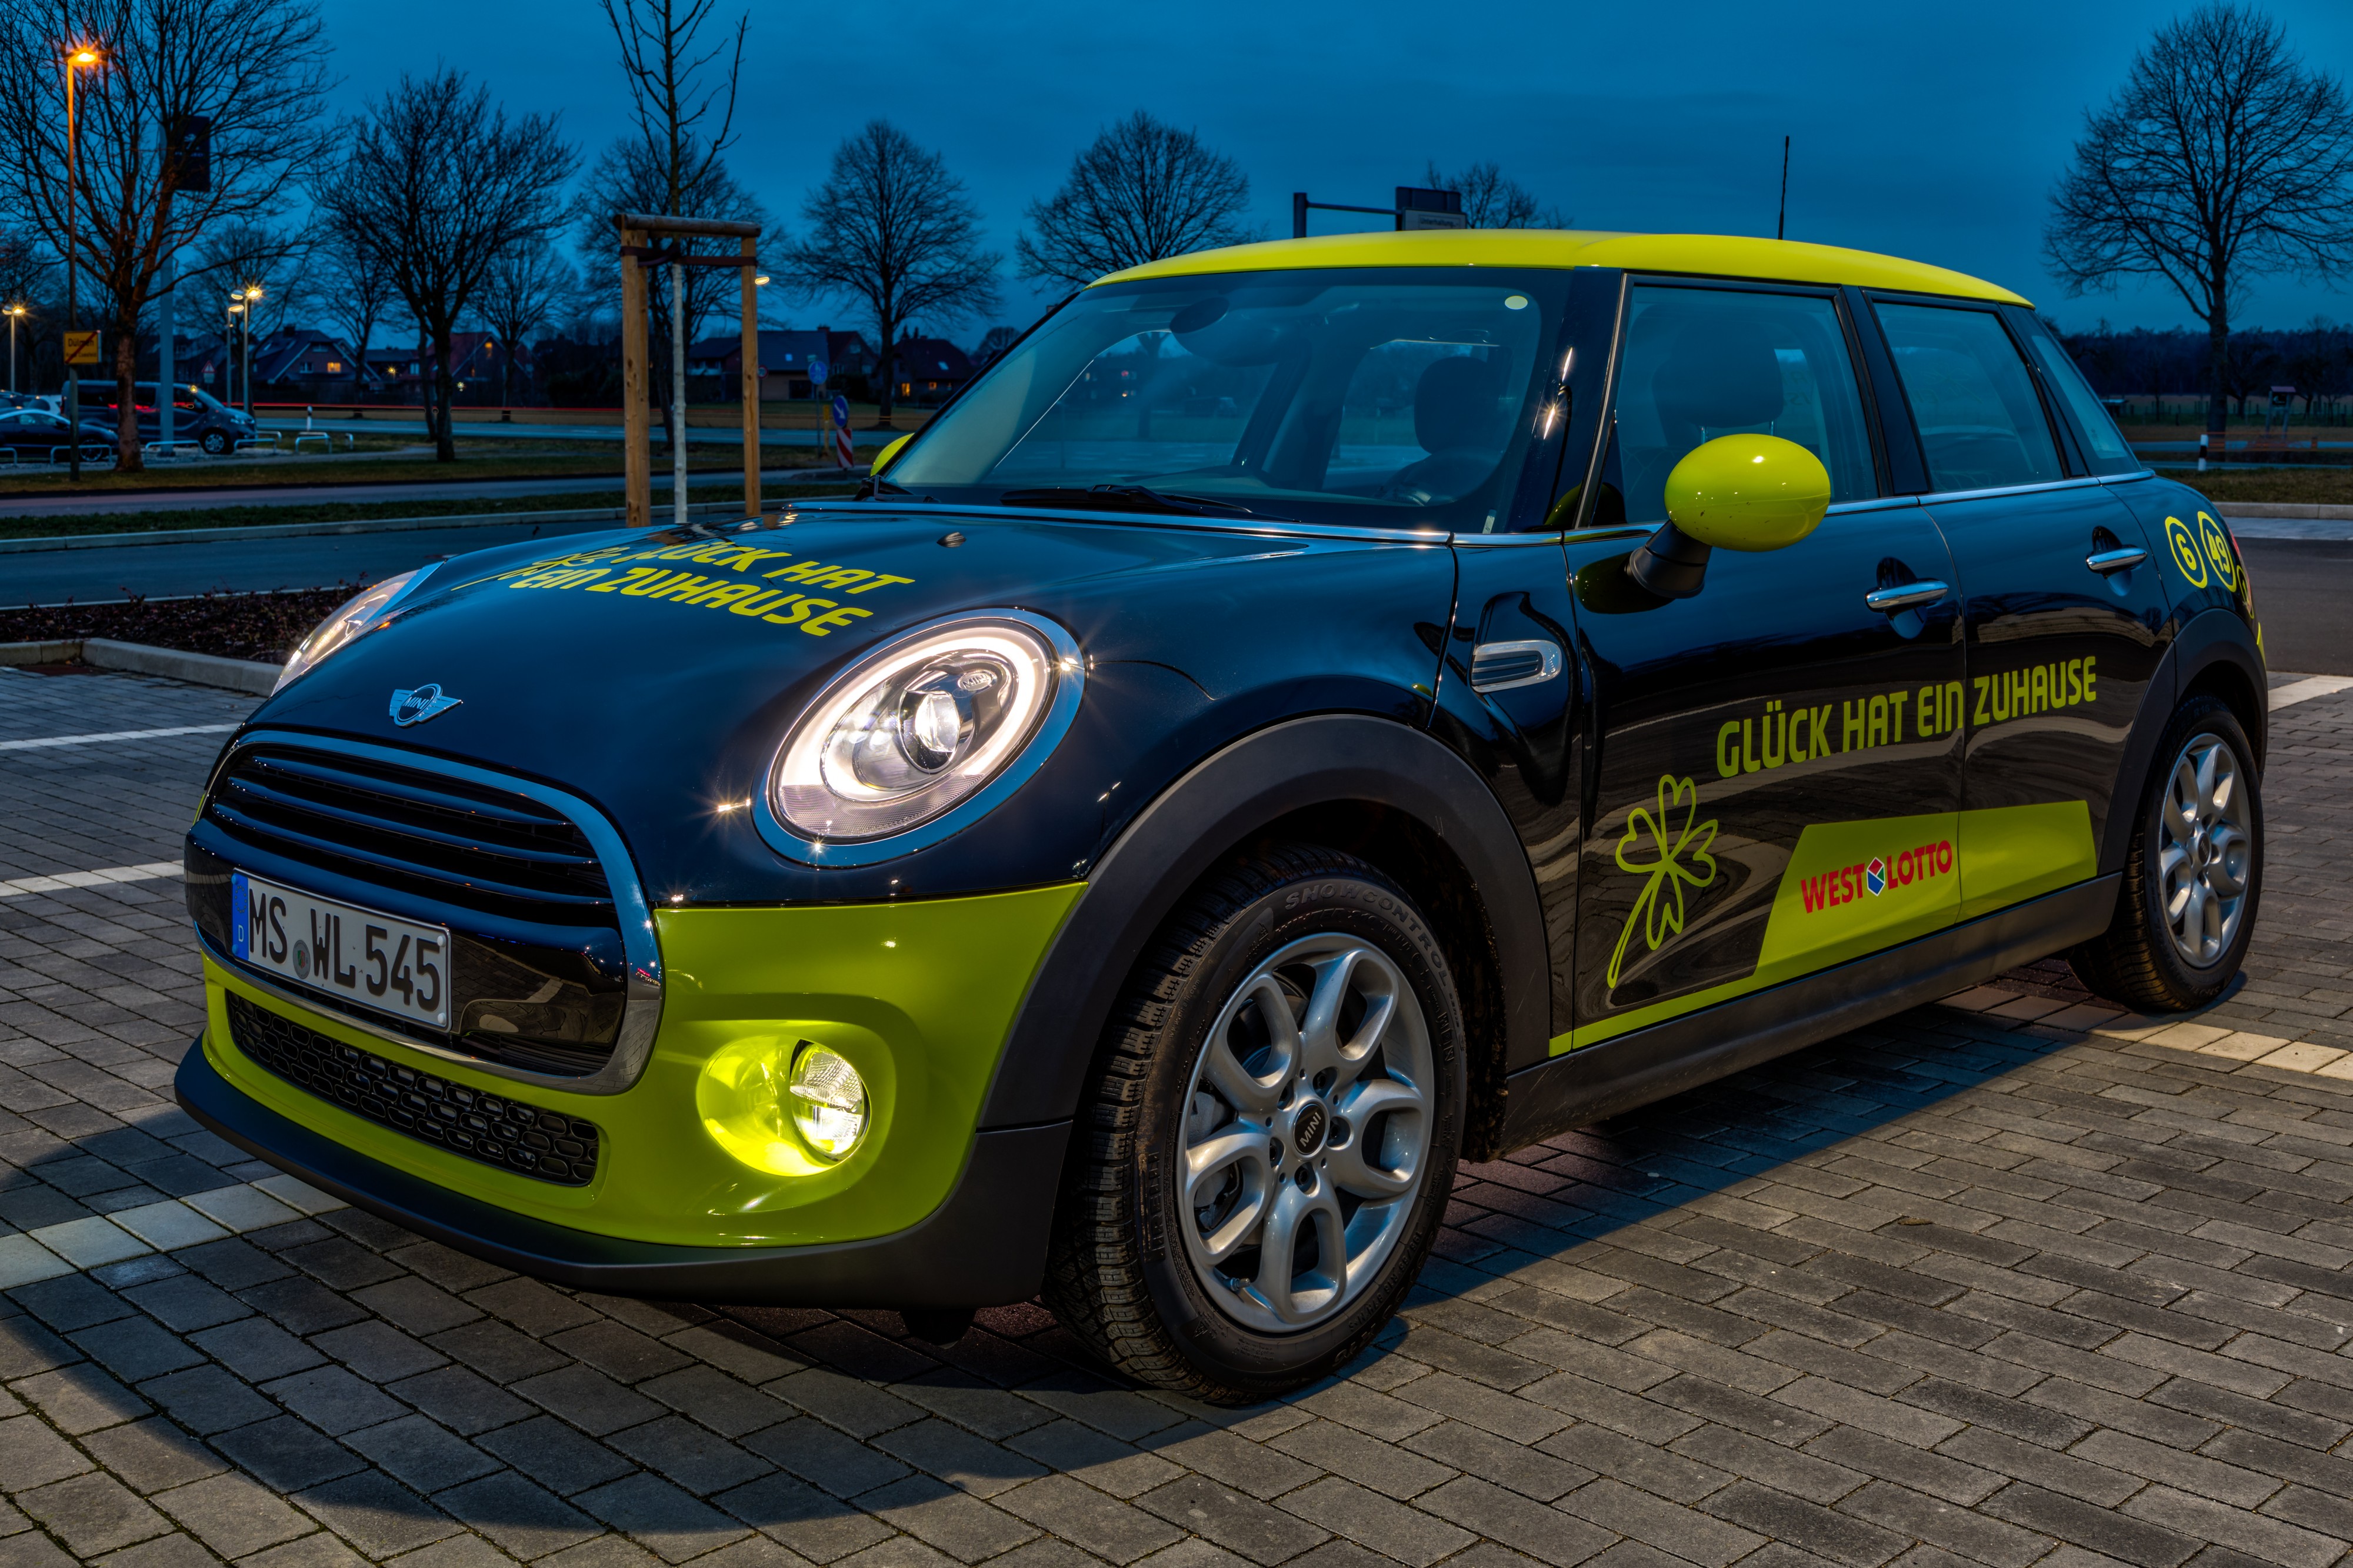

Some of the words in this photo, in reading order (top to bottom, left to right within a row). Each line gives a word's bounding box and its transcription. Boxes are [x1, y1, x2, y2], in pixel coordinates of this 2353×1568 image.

[2175, 533, 2197, 571] 6
[2206, 529, 2231, 574] 49
[762, 561, 915, 595] HAT
[509, 568, 612, 589] EIN
[585, 567, 874, 637] ZUHAUSE
[403, 696, 430, 710] MINI
[1717, 700, 1833, 778] GLÜCK
[1842, 690, 1908, 753] HAT
[1918, 681, 1964, 737] EIN
[1974, 656, 2097, 726] ZUHAUSE
[1887, 840, 1952, 890] LOTTO
[249, 889, 288, 965] MS
[310, 908, 356, 989] WL
[365, 924, 441, 1012] 545
[1285, 883, 1448, 986] SNOWCONTROL
[1299, 1112, 1322, 1147] MINI
